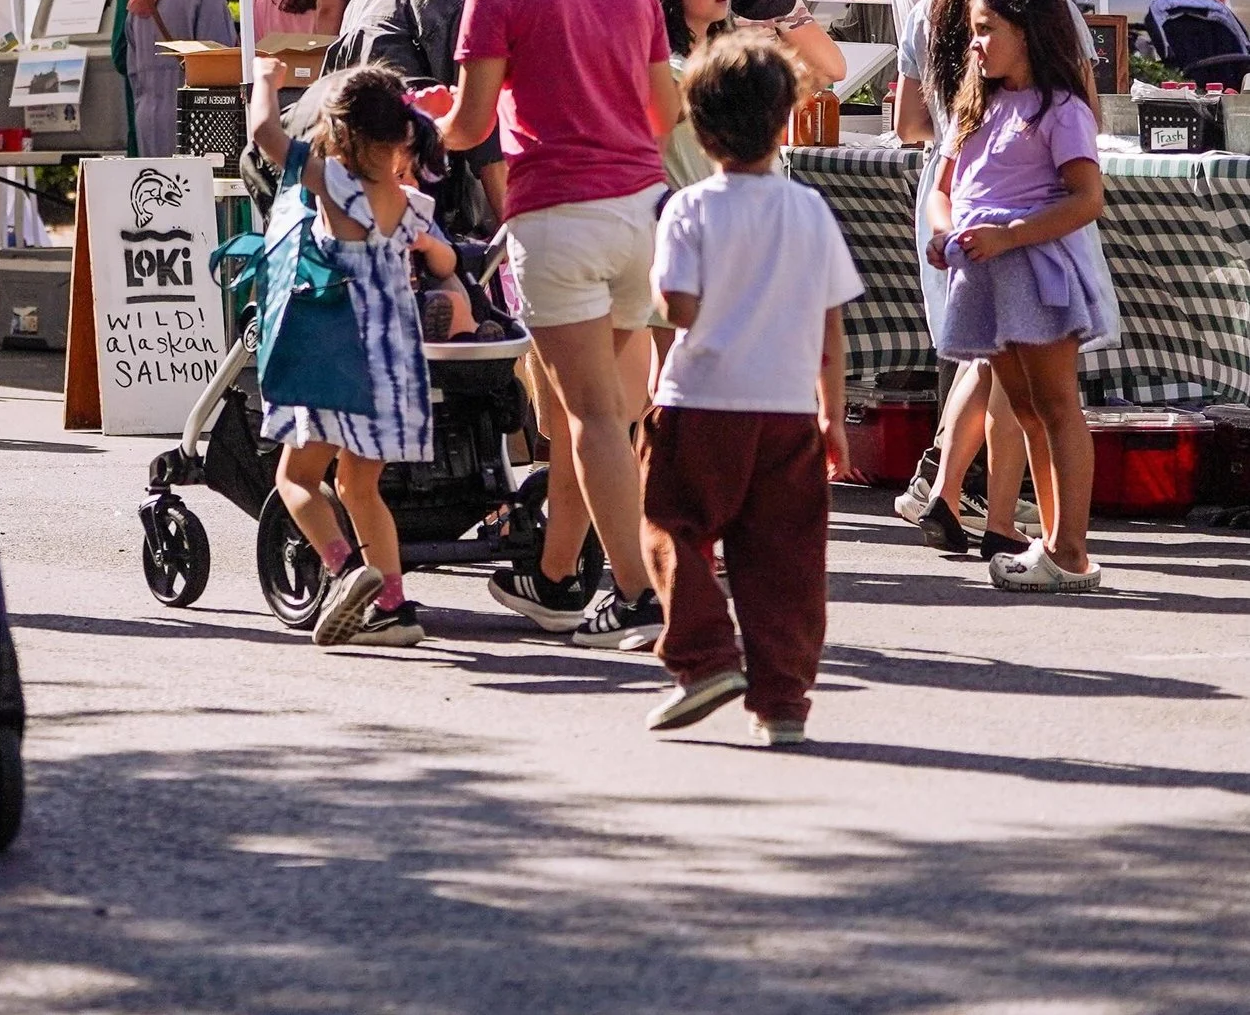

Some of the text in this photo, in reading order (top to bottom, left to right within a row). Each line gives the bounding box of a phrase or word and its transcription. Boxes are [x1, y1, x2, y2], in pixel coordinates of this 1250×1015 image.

[1154, 130, 1186, 144] Trash
[107, 307, 206, 331] WILD!
[106, 331, 219, 358] alaskan
[114, 359, 219, 388] SALMON
